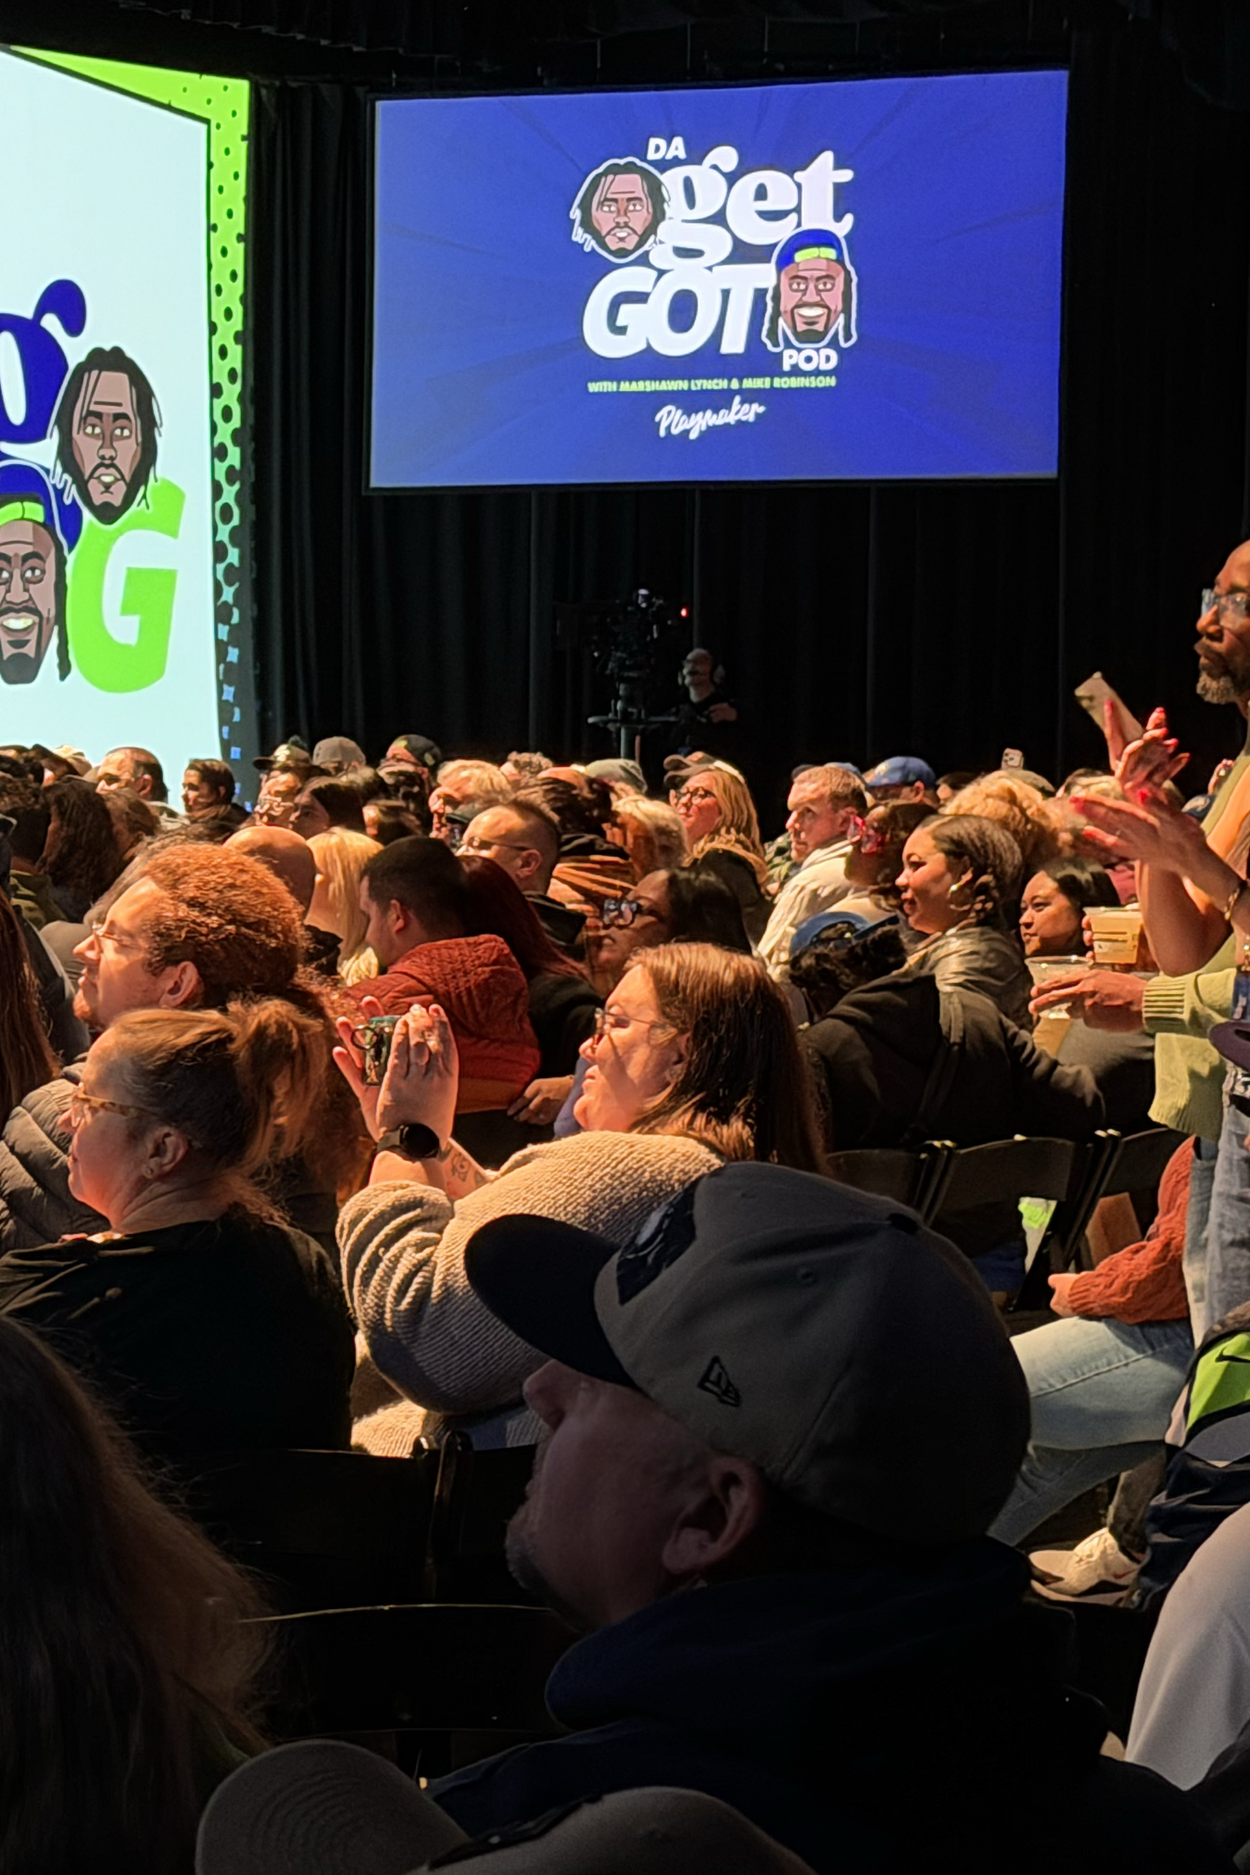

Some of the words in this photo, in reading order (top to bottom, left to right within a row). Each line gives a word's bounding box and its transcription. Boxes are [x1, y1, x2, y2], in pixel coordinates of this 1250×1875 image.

[647, 136, 687, 161] DA
[648, 145, 854, 271] get
[583, 262, 777, 358] GOT
[782, 348, 838, 371] POD
[587, 381, 617, 393] WITH
[691, 378, 728, 391] LYNCH
[730, 377, 740, 390] &
[742, 376, 771, 389] MIKE
[773, 375, 837, 389] ROBINSON
[654, 394, 766, 440] Playmaker
